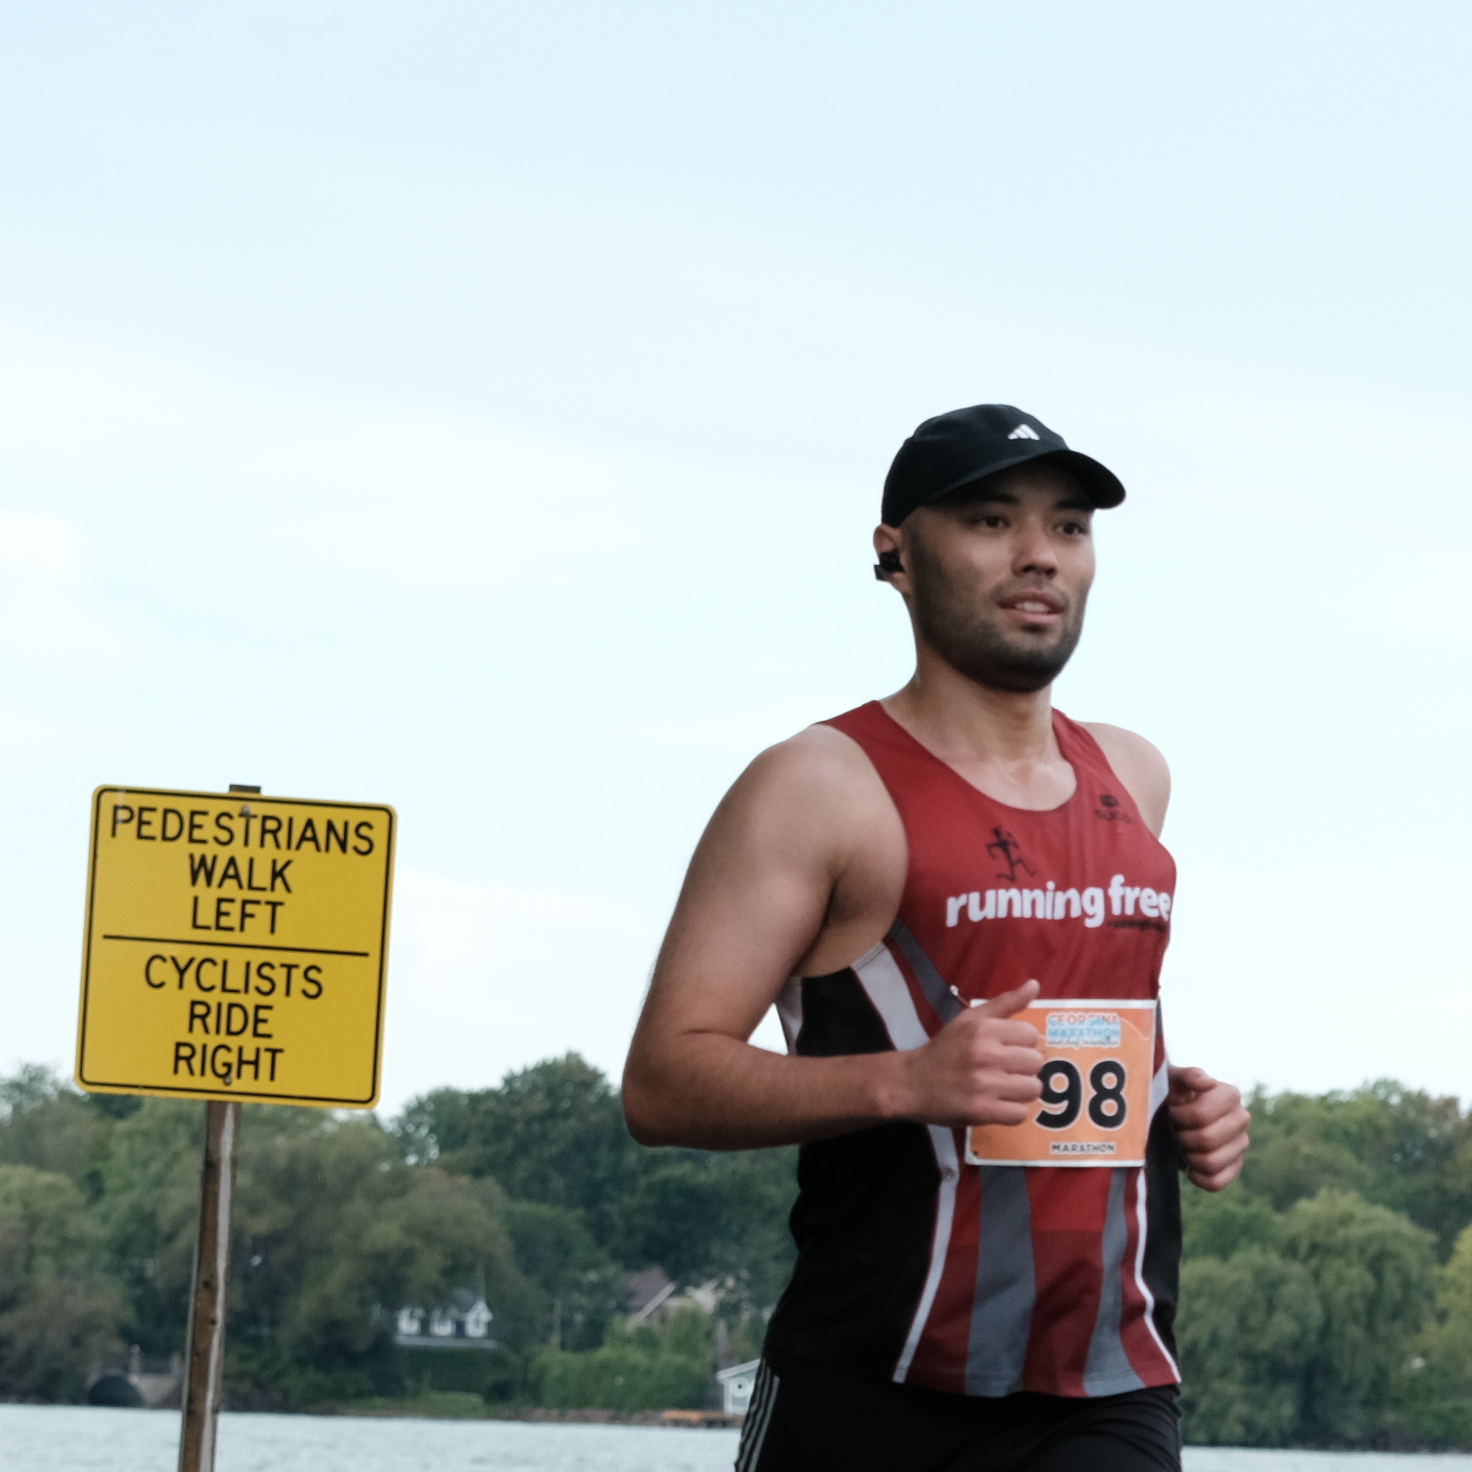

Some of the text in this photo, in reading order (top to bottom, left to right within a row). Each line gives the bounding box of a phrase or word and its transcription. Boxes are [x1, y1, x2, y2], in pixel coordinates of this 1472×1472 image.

[111, 804, 375, 856] PEDESTRIANS
[189, 853, 293, 893] WALK
[192, 896, 285, 934] LEFT
[946, 881, 1105, 928] running
[144, 954, 324, 999] CYCLISTS
[188, 1000, 274, 1039] RIDE
[173, 1042, 285, 1083] RIGHT
[1035, 1060, 1127, 1129] 98
[1051, 1144, 1115, 1153] MARATHON
